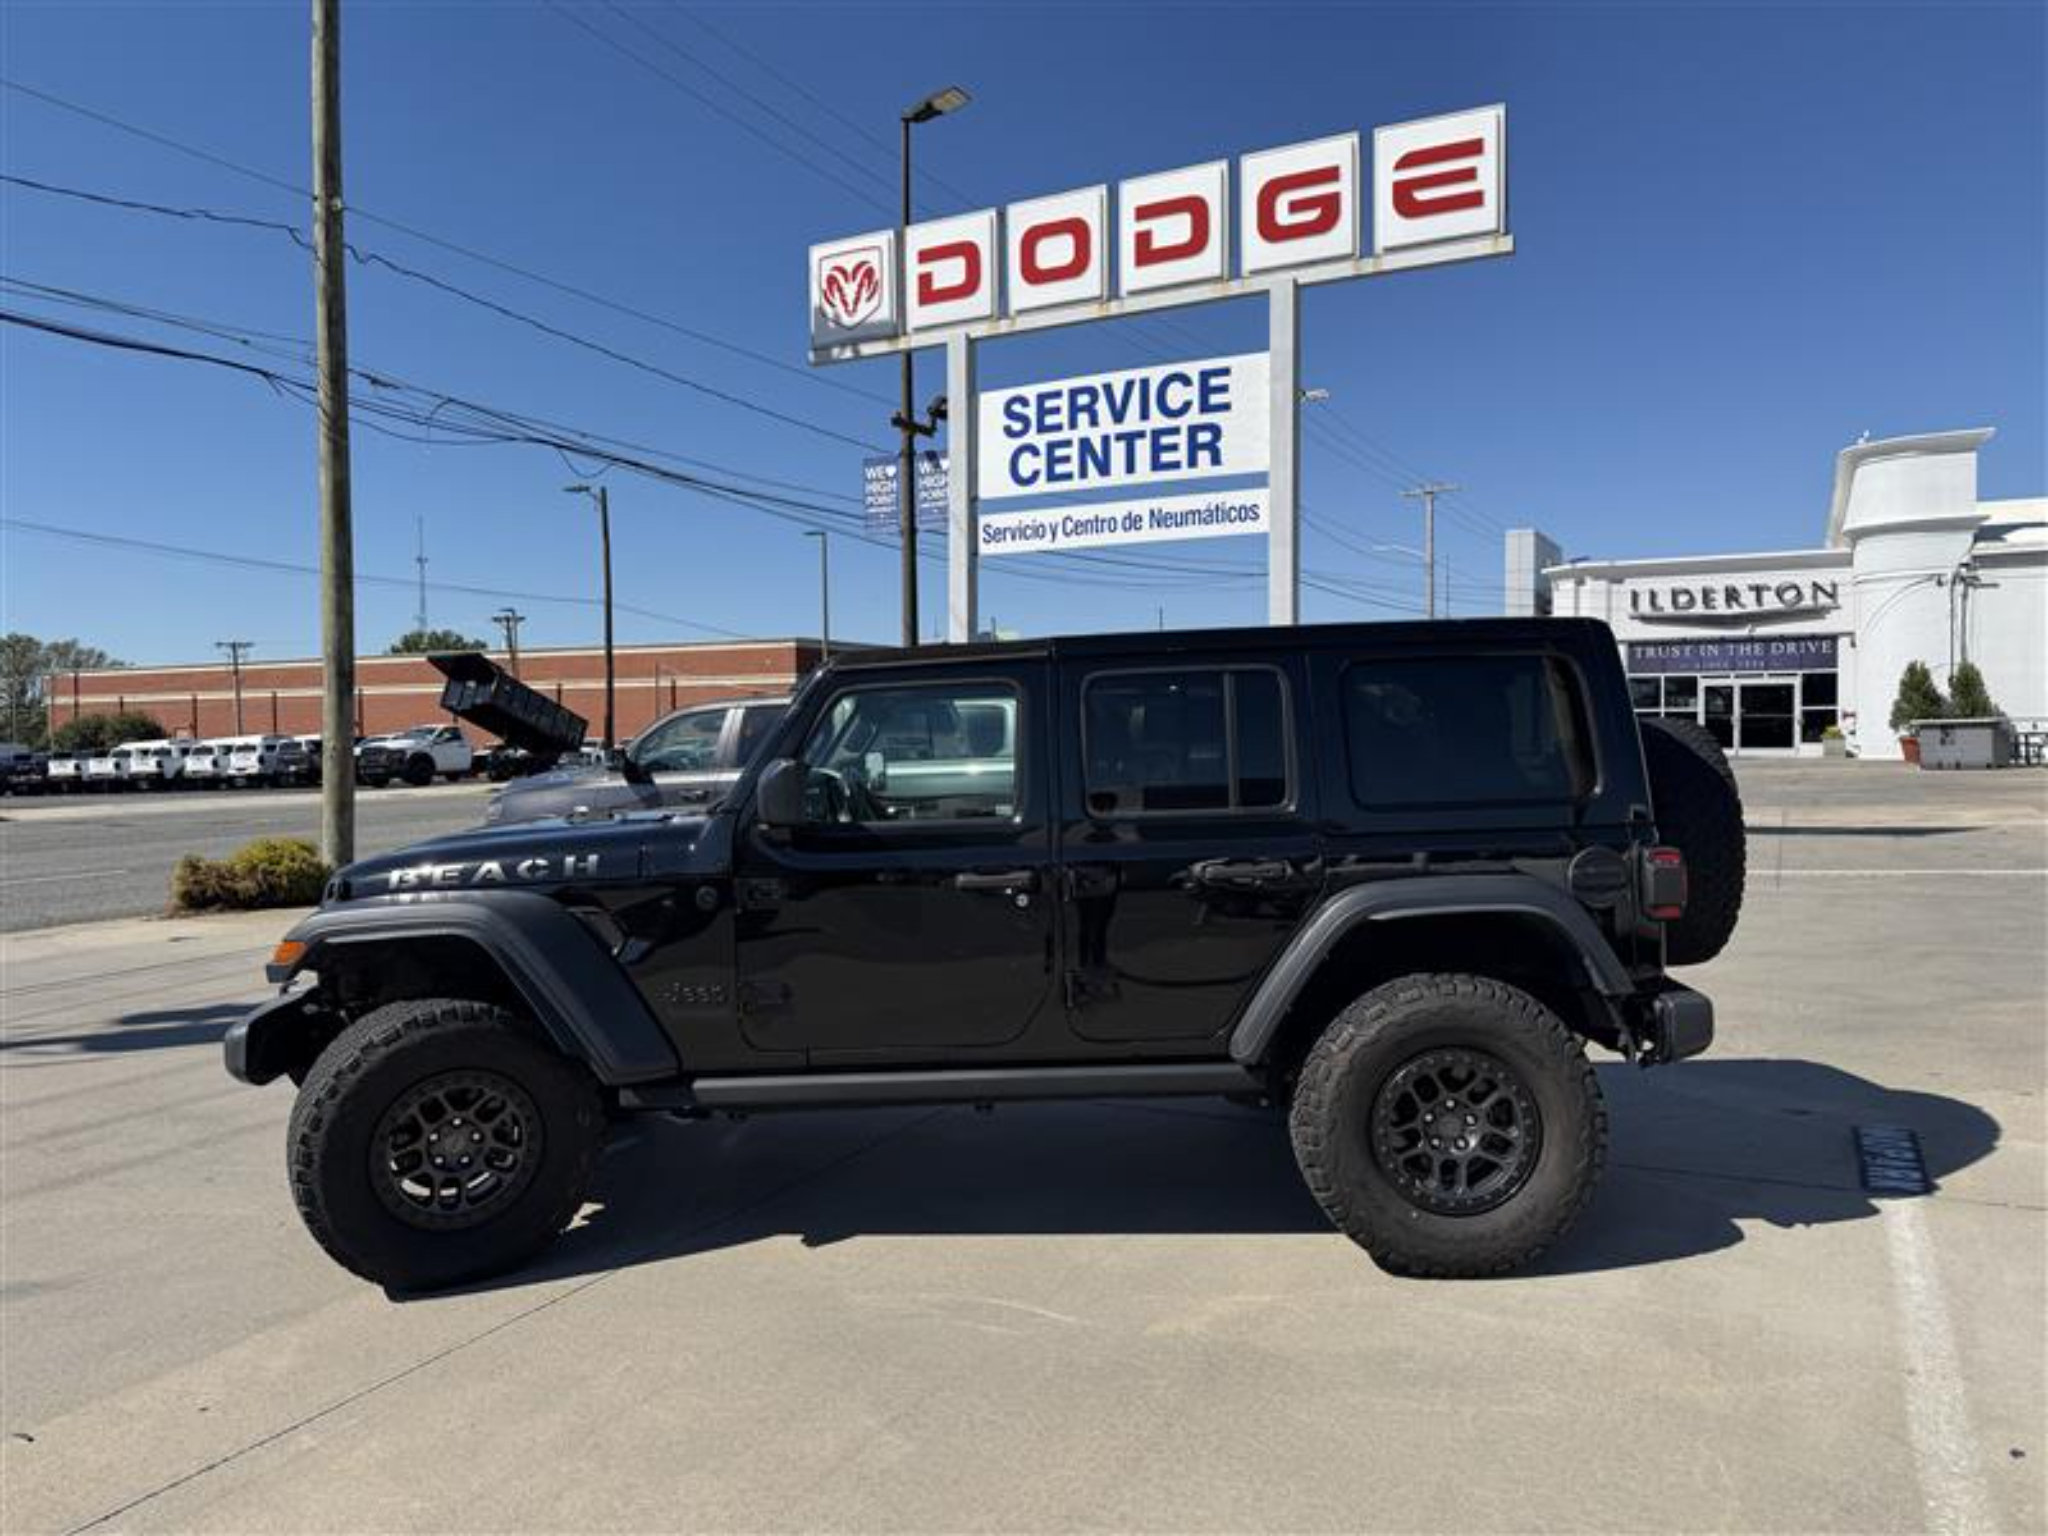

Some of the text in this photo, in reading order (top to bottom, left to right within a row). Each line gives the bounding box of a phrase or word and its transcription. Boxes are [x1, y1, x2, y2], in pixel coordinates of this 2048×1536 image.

[917, 137, 1486, 308] DODGE
[1002, 366, 1232, 439] SERVICE
[1008, 422, 1223, 487] CENTER
[864, 479, 897, 494] HIGH
[865, 465, 886, 479] WE
[864, 493, 897, 506] POINT
[982, 502, 1261, 545] Servicio y Centro de Neumáticos
[1629, 580, 1840, 613] ILDERTON
[1634, 639, 1833, 659] TRUST IN THE DRIVE
[388, 854, 600, 889] BEACH
